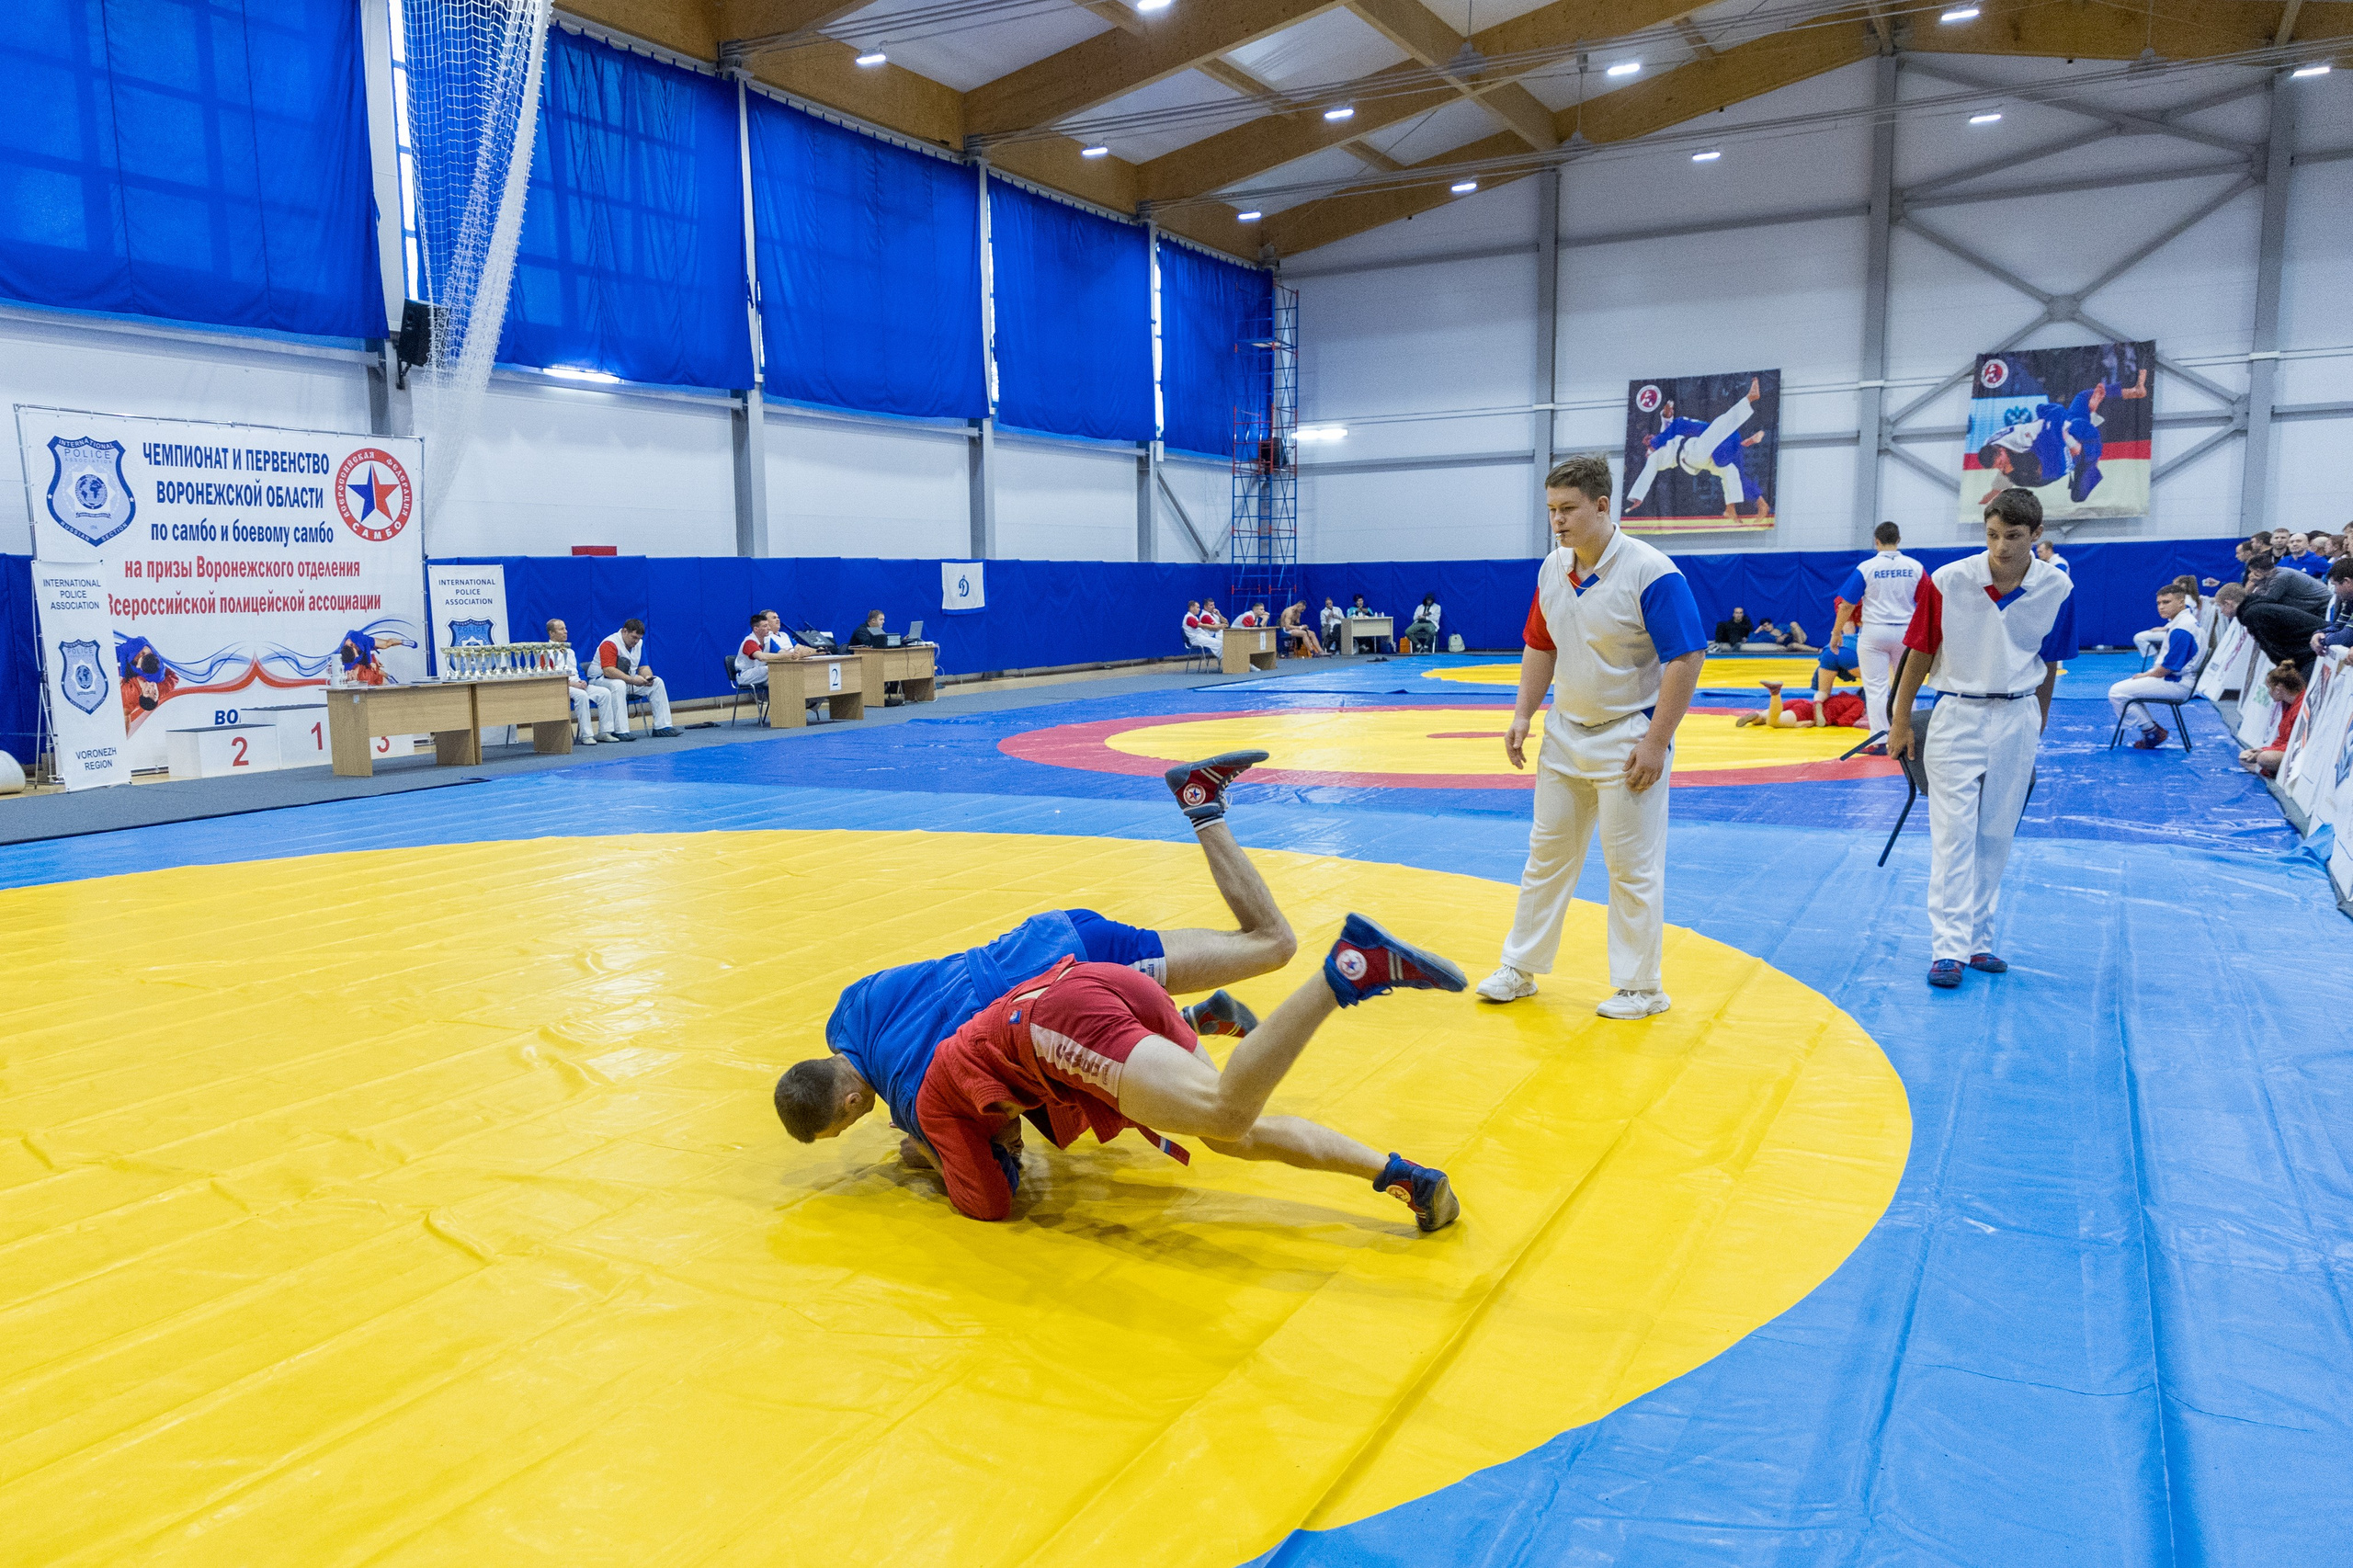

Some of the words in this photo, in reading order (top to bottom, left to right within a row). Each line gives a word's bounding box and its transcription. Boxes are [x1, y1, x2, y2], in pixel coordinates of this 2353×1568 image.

[58, 438, 113, 449] INTERNATIONAL
[64, 449, 110, 459] POLICE
[142, 442, 229, 470] ЧЕМПИОНАТ
[233, 448, 242, 470] И
[245, 449, 330, 474] ПЕРВЕНСТВО
[156, 478, 262, 506] ВОРОНЕЖСКОЙ
[267, 485, 324, 508] ОБЛАСТИ
[151, 523, 168, 541] по
[172, 517, 217, 541] самбо
[221, 525, 229, 541] и
[233, 518, 290, 548] боевому
[293, 521, 334, 543] самбо
[352, 521, 402, 540] САМБО
[125, 561, 142, 578] на
[147, 560, 192, 583] призы
[197, 555, 293, 582] Воронежского
[297, 561, 360, 580] отделения
[1874, 569, 1914, 579] REFEREE
[43, 578, 101, 587] INTERNATIONAL
[60, 590, 87, 598] POLICE
[220, 589, 305, 616] полицейской
[309, 594, 381, 614] ассоциации
[51, 601, 99, 609] ASSOCIATION
[831, 668, 838, 687] 2
[214, 709, 242, 725] ВО
[311, 722, 324, 750] 1
[377, 736, 390, 753] 3
[75, 747, 117, 759] VORONEZH
[231, 737, 249, 767] 2
[85, 759, 113, 770] REGION
